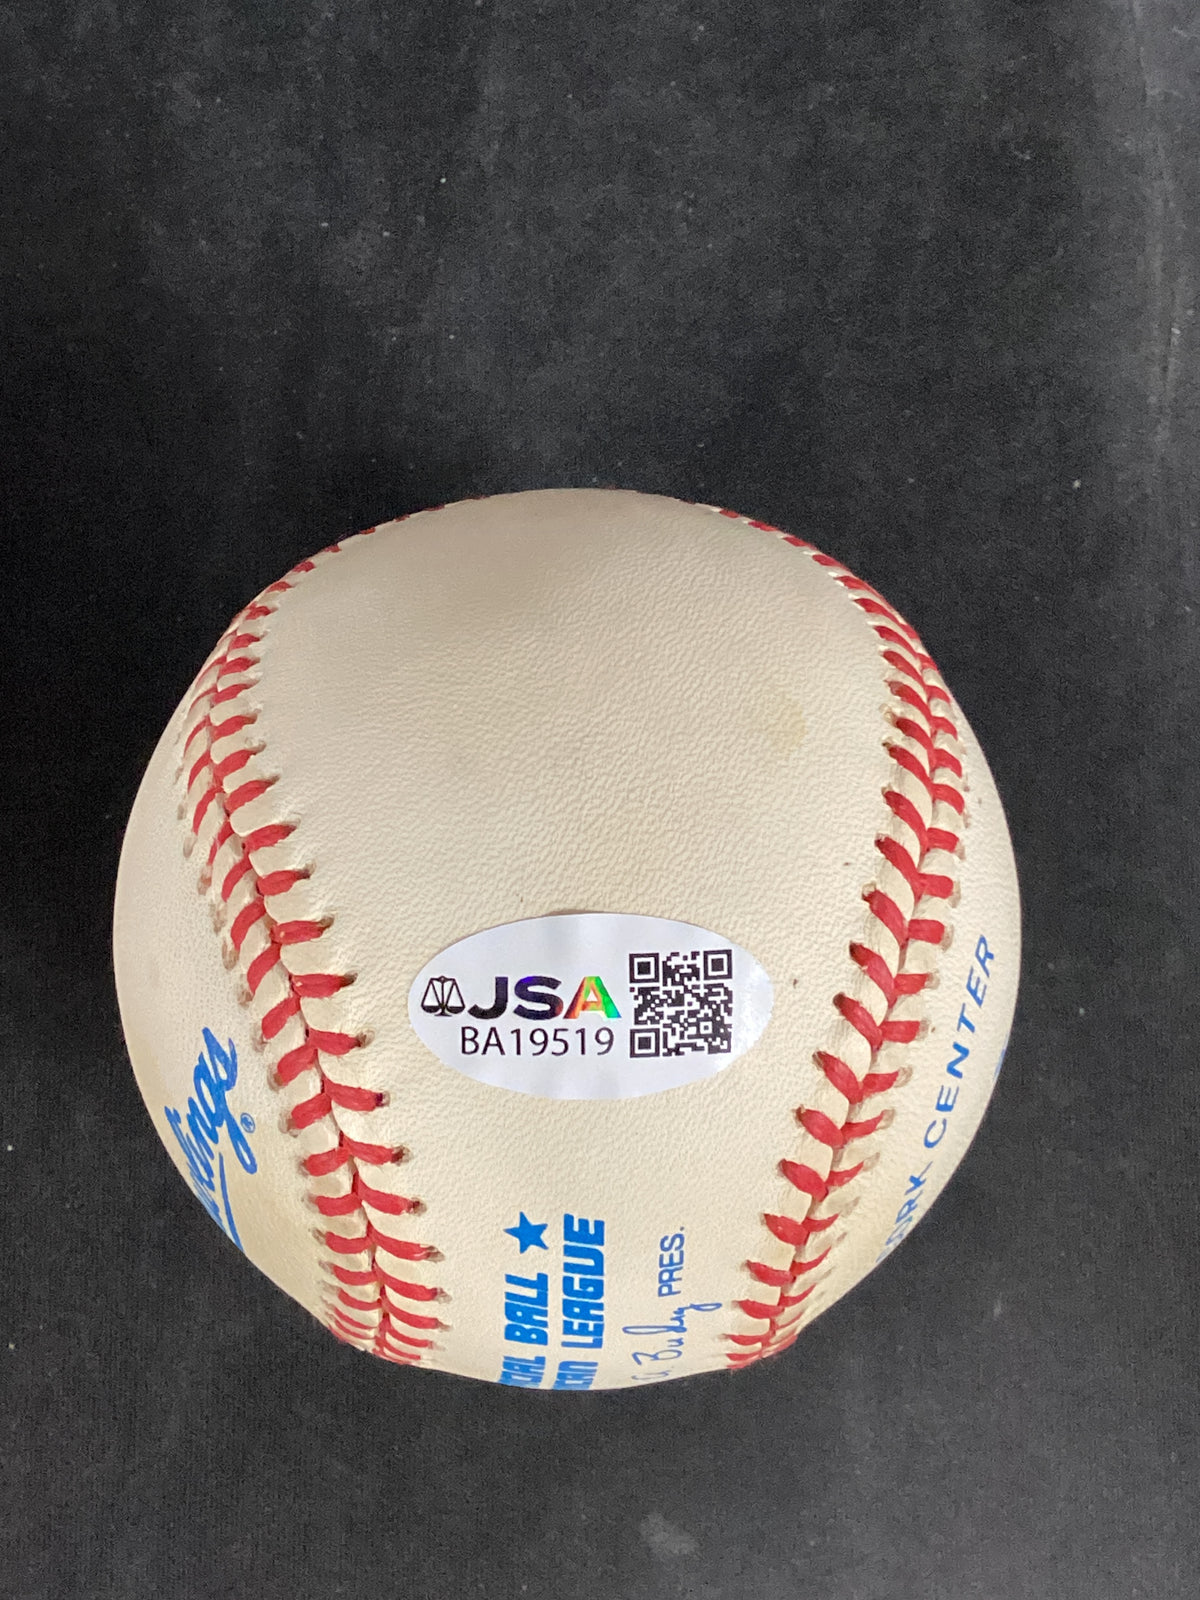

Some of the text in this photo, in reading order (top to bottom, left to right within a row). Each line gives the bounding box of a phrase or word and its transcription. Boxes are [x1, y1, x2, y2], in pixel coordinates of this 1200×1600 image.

[467, 975, 622, 1020] JSA
[460, 1026, 614, 1056] BA19519
[923, 934, 995, 1148] CENTER
[561, 1213, 605, 1349] LEAGUE
[658, 1226, 685, 1298] PRES.
[504, 1272, 548, 1346] BALL
